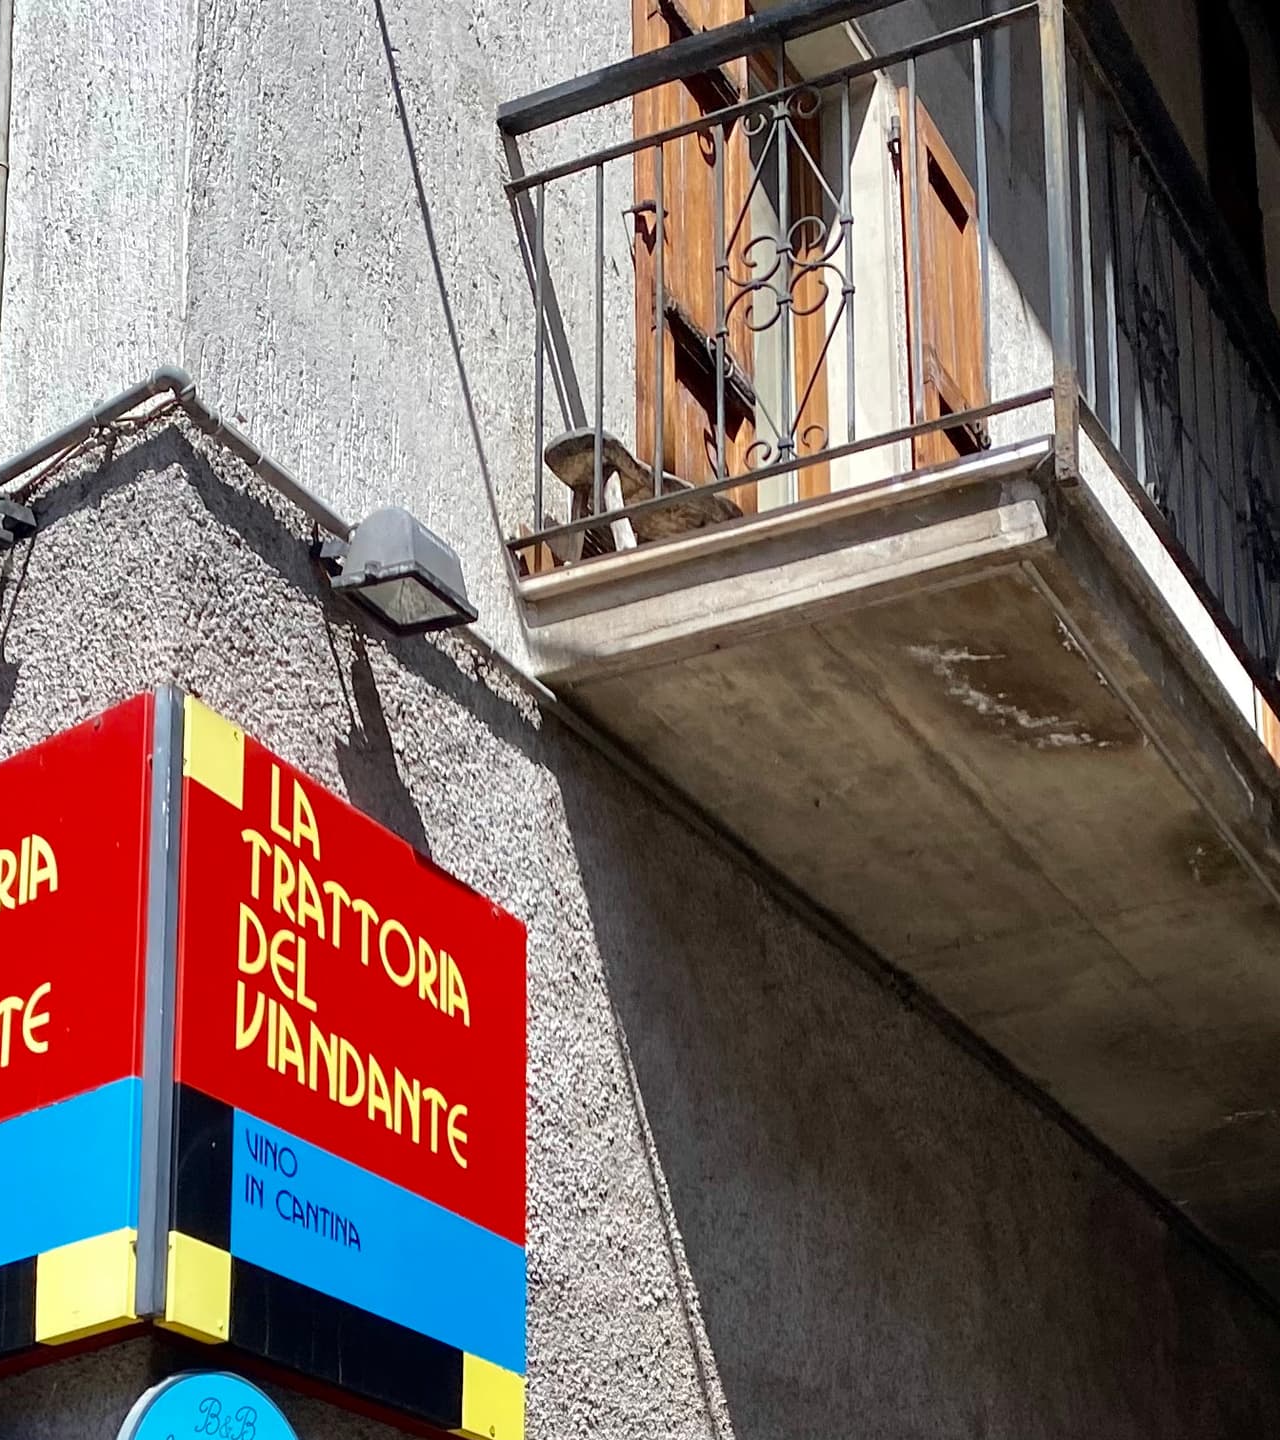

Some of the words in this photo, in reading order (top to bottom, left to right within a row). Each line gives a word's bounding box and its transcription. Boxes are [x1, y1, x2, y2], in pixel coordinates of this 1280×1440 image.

[270, 763, 321, 861] LA
[237, 902, 318, 1012] DEL
[241, 828, 470, 1027] TRATTORIA
[235, 980, 468, 1169] VIANDANTE
[245, 1127, 298, 1178] VINO
[245, 1173, 264, 1209] IN
[276, 1189, 361, 1252] CANTINA
